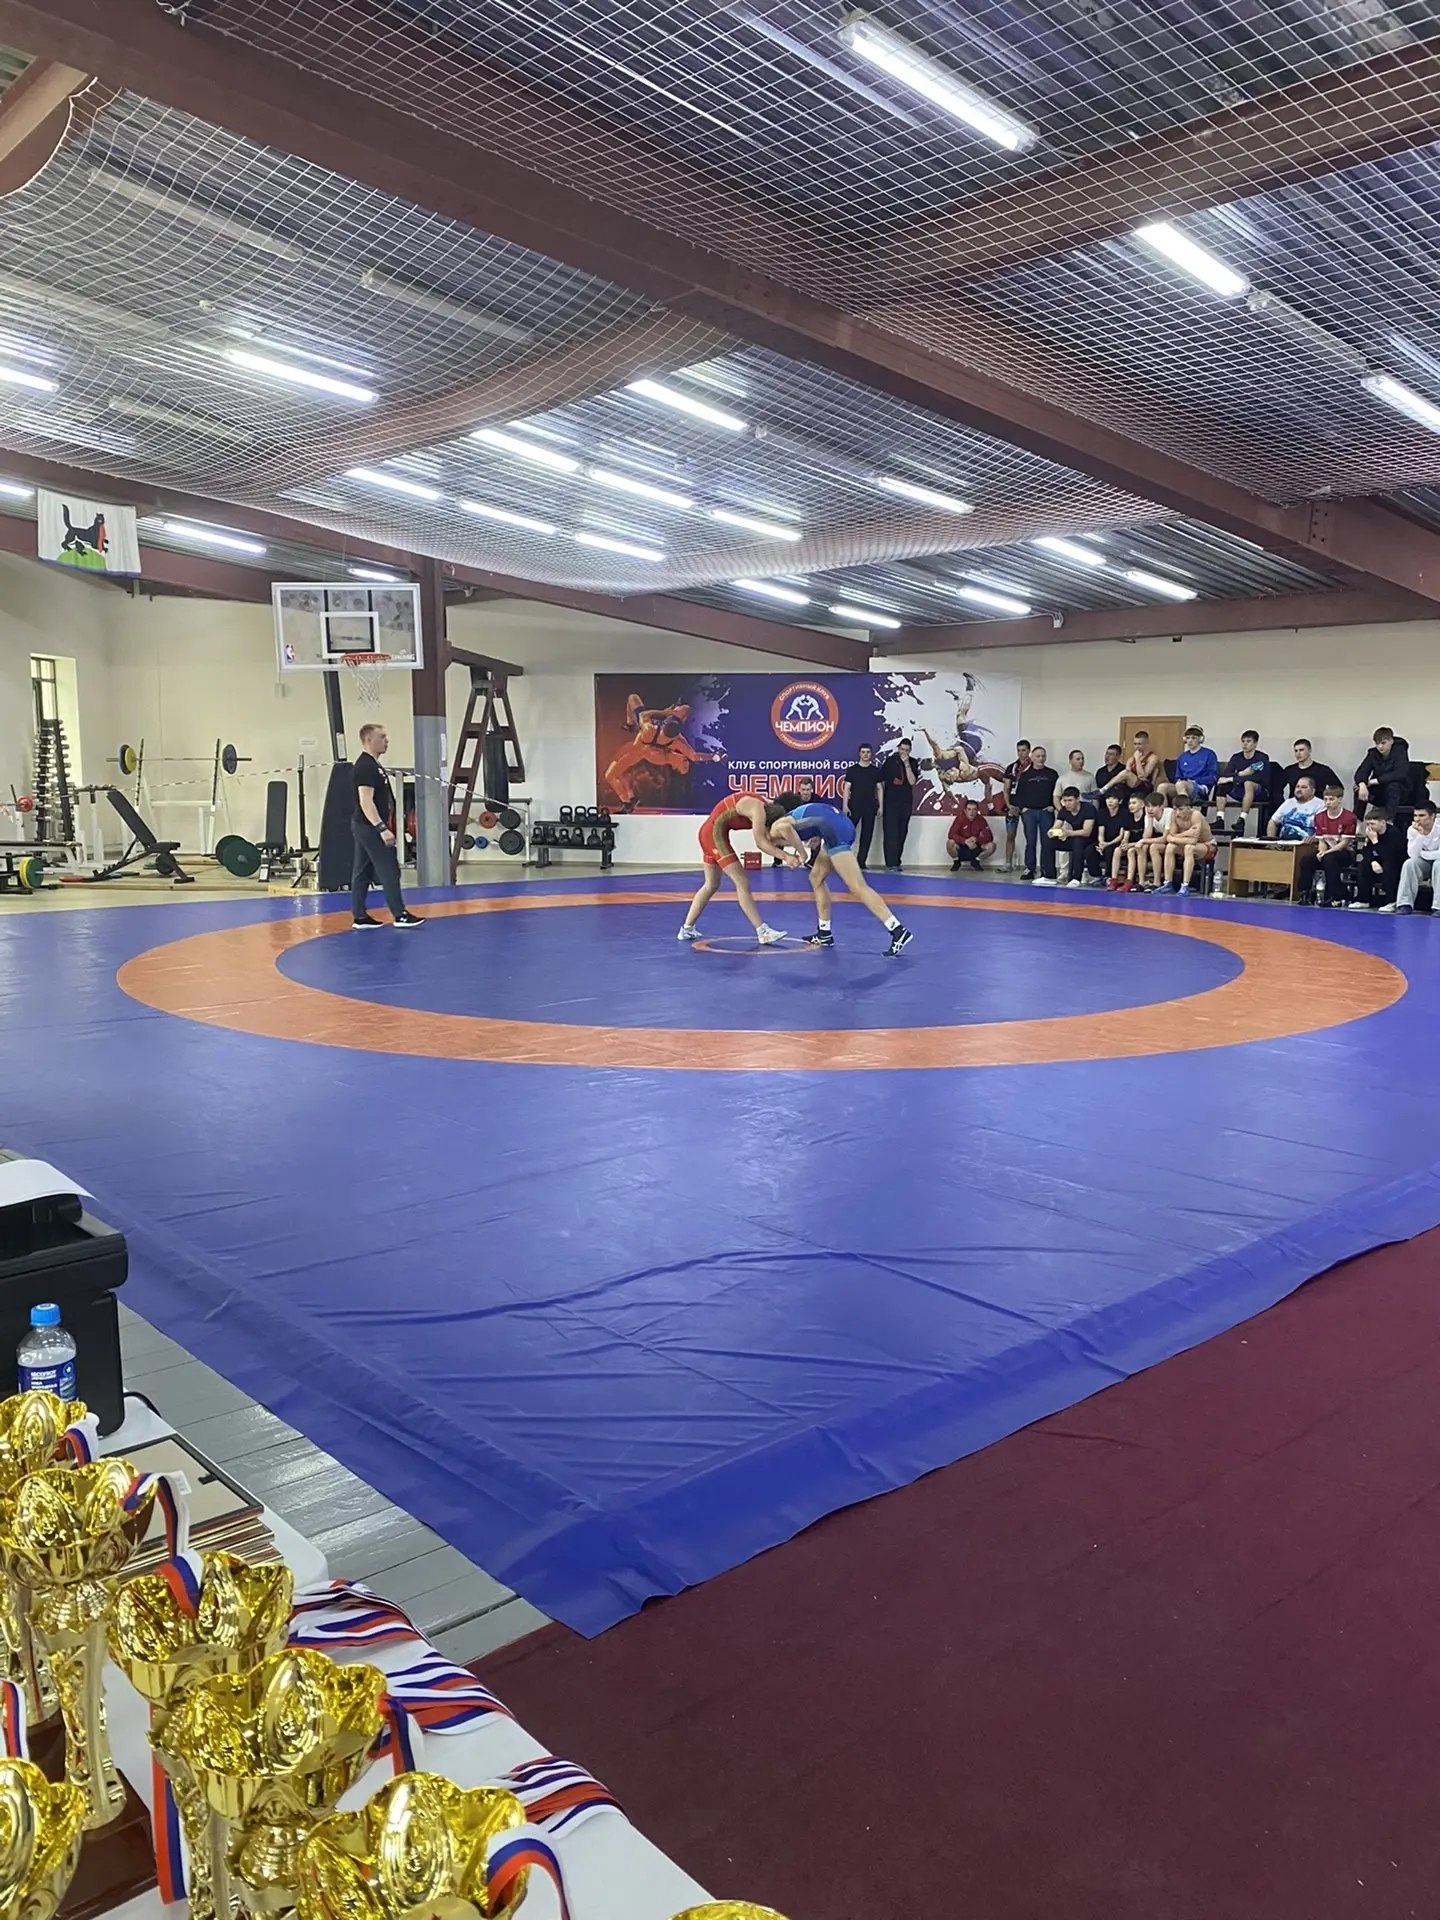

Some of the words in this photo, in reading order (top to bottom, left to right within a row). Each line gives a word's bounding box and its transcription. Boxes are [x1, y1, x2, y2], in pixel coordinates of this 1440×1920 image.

[775, 720, 835, 732] ЧЕМПИОН
[728, 760, 756, 770] КЛУБ
[758, 759, 831, 770] СПОРТИВНОЙ
